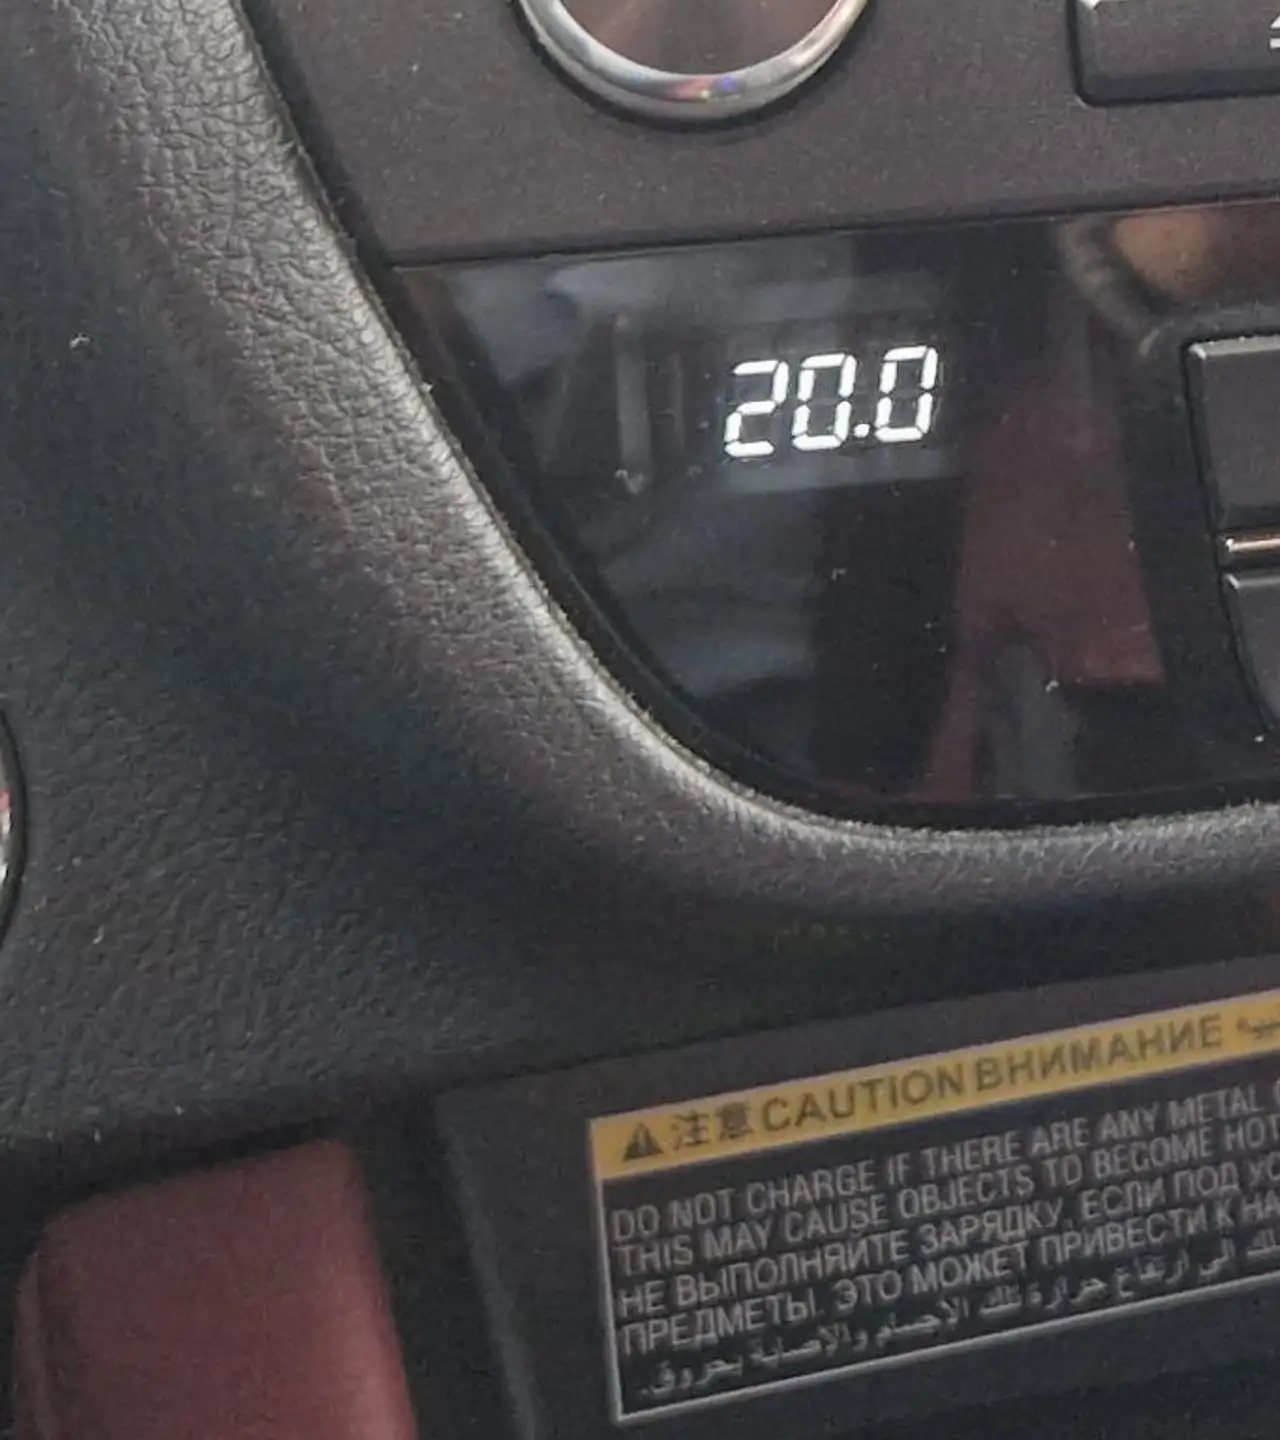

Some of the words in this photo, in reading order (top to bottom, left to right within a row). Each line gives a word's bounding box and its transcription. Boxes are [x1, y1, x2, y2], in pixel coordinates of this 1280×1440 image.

[724, 345, 938, 458] 20.0
[671, 1102, 752, 1150] 注意
[760, 1065, 963, 1132] CAUTION
[974, 1015, 1220, 1091] ВНИМАНИЕ
[611, 1204, 660, 1241] DO
[670, 1188, 732, 1228] NOT
[746, 1160, 873, 1213] CHARGE
[887, 1152, 909, 1185] IF
[922, 1131, 1018, 1176] THERE
[1031, 1117, 1087, 1155] ARE
[1100, 1105, 1157, 1140] ANY
[1167, 1086, 1259, 1127] METAL
[617, 1233, 693, 1275] THIS
[702, 1220, 770, 1259] MAY
[784, 1193, 885, 1242] CAUSE
[897, 1164, 1033, 1219] OBJECTS
[1042, 1154, 1082, 1186] TO
[1091, 1128, 1210, 1178] BECOME
[1223, 1114, 1280, 1151] HOT
[618, 1279, 664, 1317] НЕ
[675, 1229, 907, 1304] ВЫПОЛНЯЙТЕ
[1080, 1177, 1164, 1220] ЕСЛИ
[1173, 1161, 1239, 1198] ПОД
[834, 1269, 902, 1310] ЭТО
[910, 1241, 1027, 1293] МОЖЕТ
[1040, 1206, 1206, 1263] ПРИВЕСТИ
[1214, 1199, 1233, 1228] К
